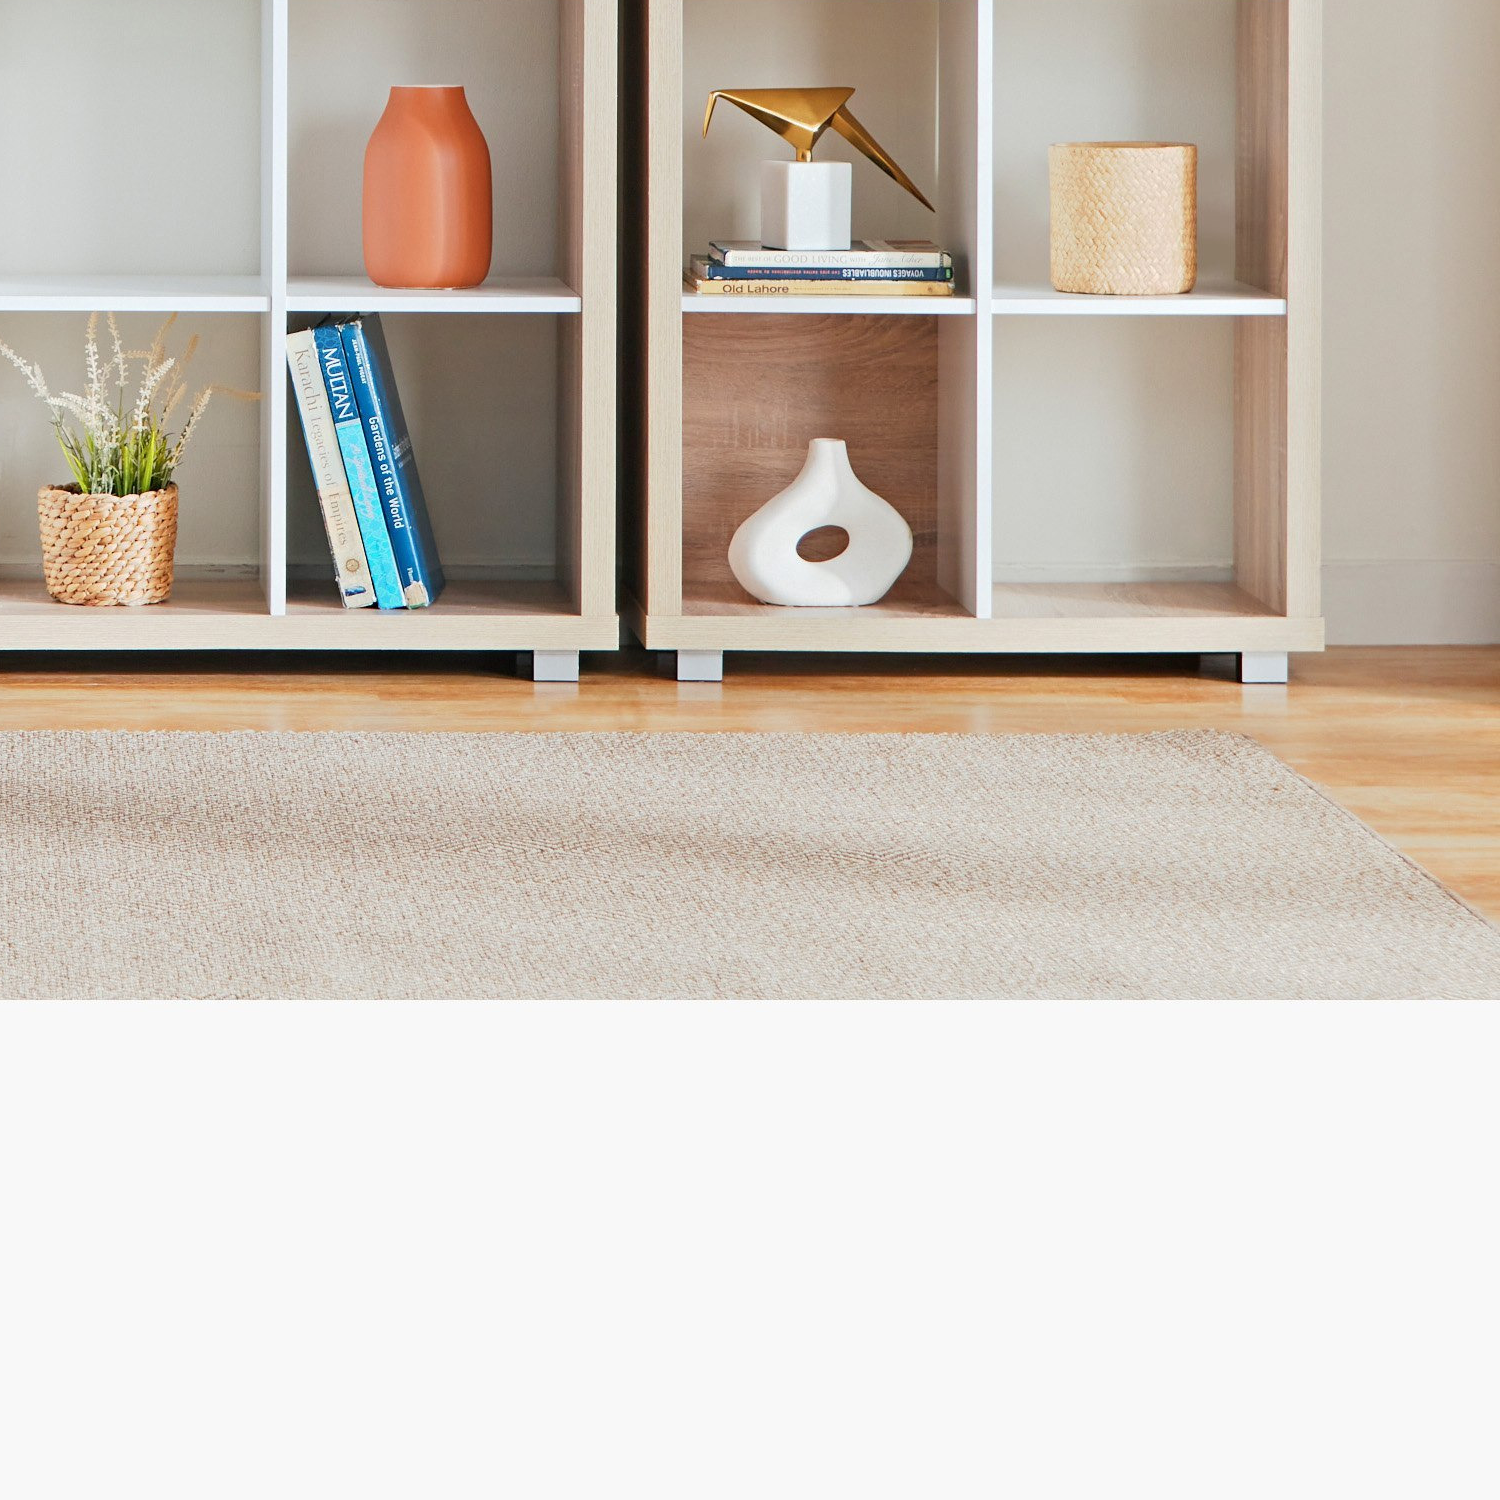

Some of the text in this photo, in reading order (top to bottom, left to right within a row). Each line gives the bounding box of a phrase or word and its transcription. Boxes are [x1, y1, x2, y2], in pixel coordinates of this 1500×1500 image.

[774, 254, 808, 264] GOOD
[812, 254, 848, 264] LIVING
[842, 269, 892, 278] INOUBLIABLES
[893, 269, 924, 277] VOYAGES
[722, 284, 743, 294] Old
[747, 284, 789, 294] Lahore
[322, 347, 354, 419] MULTAN
[295, 349, 346, 546] Karachi Legacies of Empires
[368, 416, 404, 529] Gardens of the World
